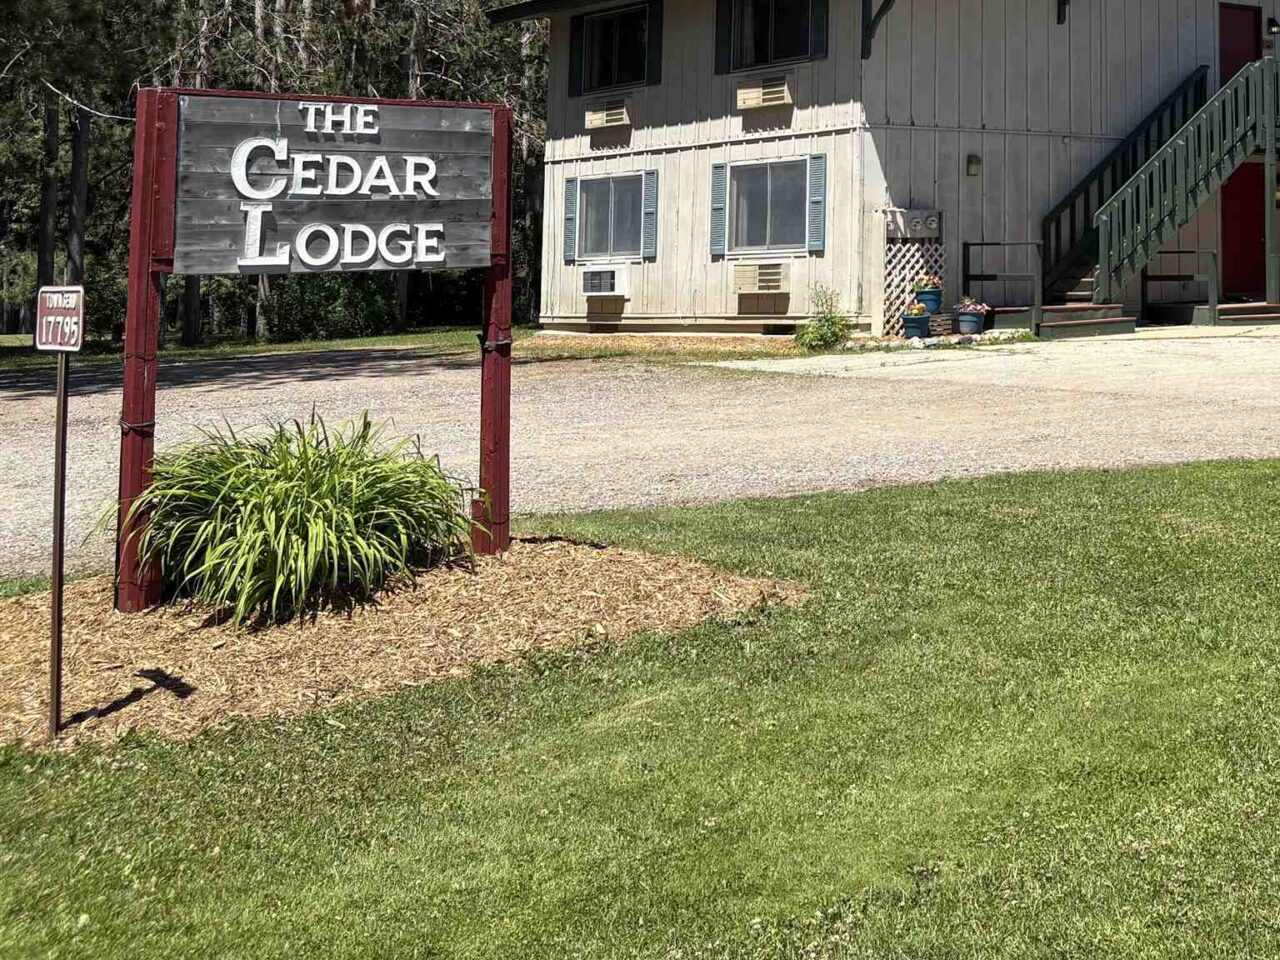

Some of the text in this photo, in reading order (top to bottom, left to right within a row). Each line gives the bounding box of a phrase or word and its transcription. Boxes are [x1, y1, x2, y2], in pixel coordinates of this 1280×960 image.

[299, 101, 380, 135] THE
[231, 137, 440, 199] CEDAR
[237, 201, 446, 266] LODGE
[42, 316, 78, 345] 17795
